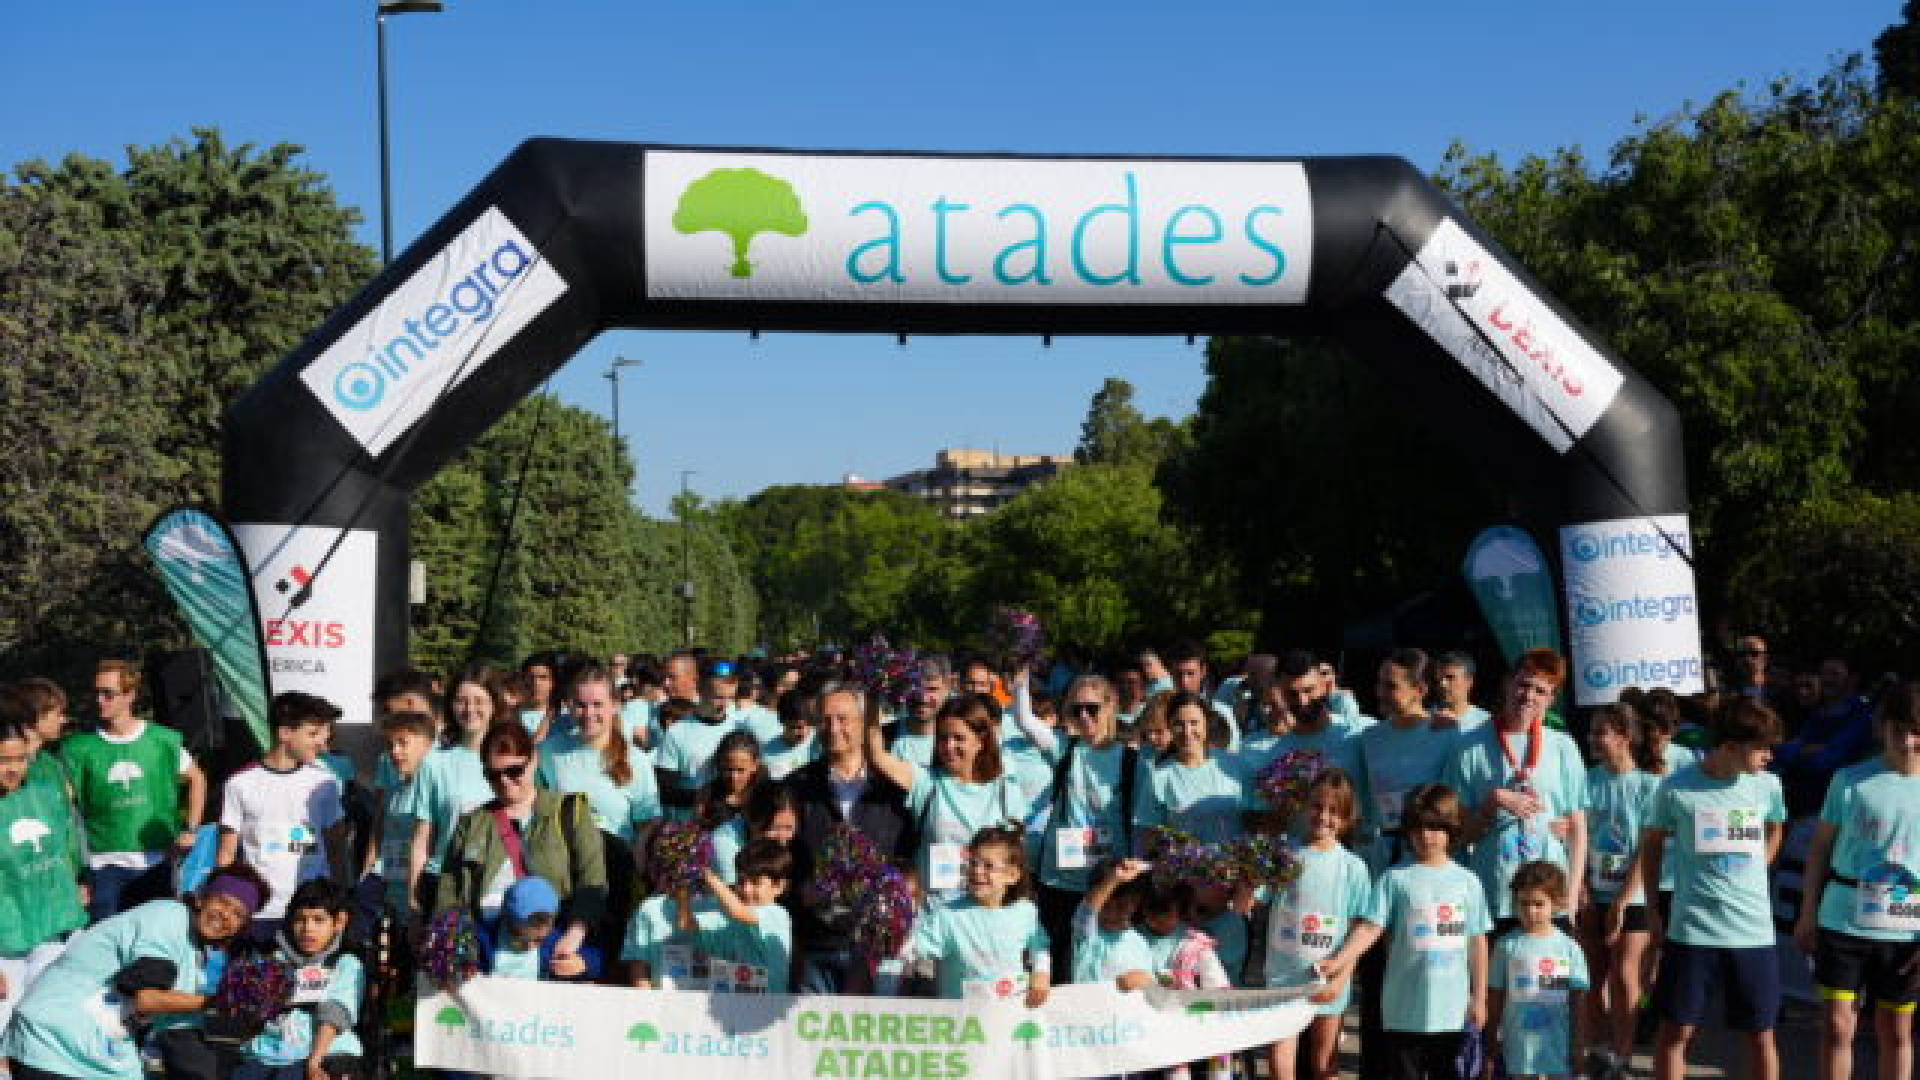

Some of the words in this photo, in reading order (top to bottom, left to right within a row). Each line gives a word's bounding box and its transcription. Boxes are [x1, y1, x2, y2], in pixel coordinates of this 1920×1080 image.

[845, 170, 1288, 287] atades
[375, 239, 532, 382] integra
[265, 619, 346, 649] EXIS
[797, 1010, 986, 1043] CARRERA
[815, 1048, 970, 1079] ATADES
